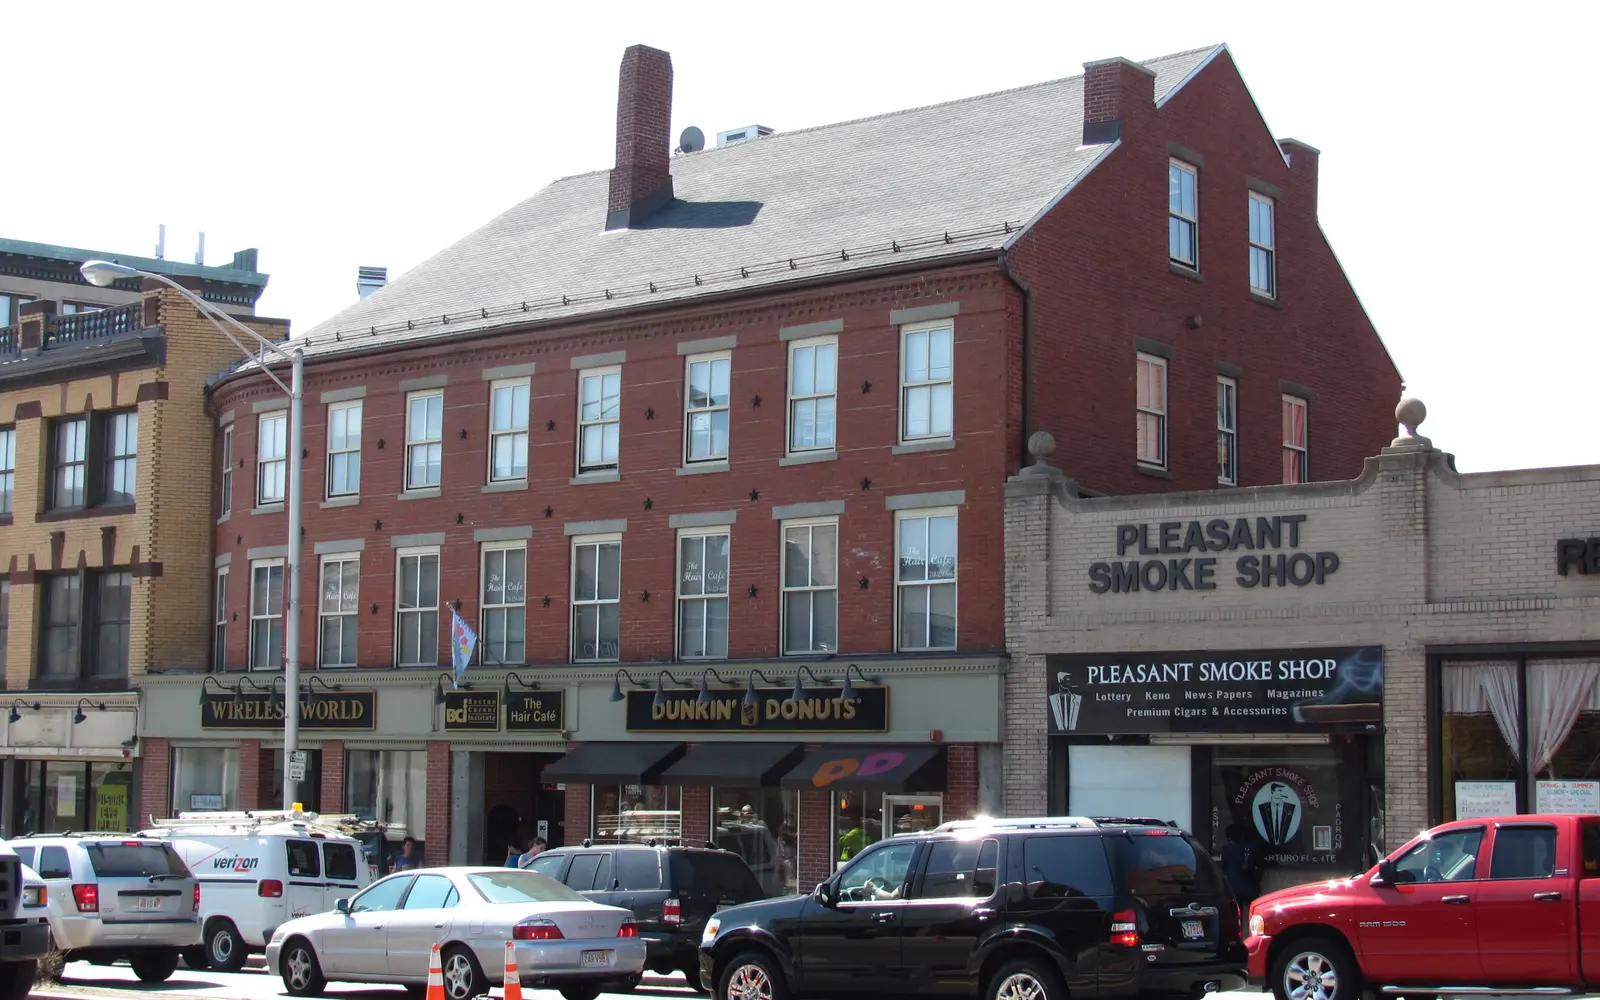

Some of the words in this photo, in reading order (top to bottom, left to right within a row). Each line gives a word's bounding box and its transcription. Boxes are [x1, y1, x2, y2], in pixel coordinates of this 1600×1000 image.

[1116, 514, 1307, 556] PLEASANT
[1088, 557, 1217, 594] SMOKE
[1235, 551, 1340, 588] SHOP
[1086, 662, 1194, 685] PLEASANT
[1199, 660, 1273, 682] SMOKE
[1278, 658, 1337, 680] SHOP
[524, 697, 542, 709] The
[1095, 691, 1132, 703] Lottery
[1145, 691, 1170, 700] Keno
[1184, 690, 1213, 700] News
[1216, 689, 1253, 701] Papers
[1267, 688, 1324, 699] Magazines
[211, 700, 296, 720] WIRELES
[299, 699, 364, 720] WORLD
[511, 710, 531, 722] Hair
[533, 710, 557, 722] Café
[652, 699, 738, 721] DUNKIN'
[1126, 707, 1171, 717] Premium
[1174, 706, 1208, 717] Cigars
[1211, 706, 1220, 716] &
[1223, 706, 1288, 716] Accessories
[1234, 767, 1275, 805] PLEASANT
[1275, 767, 1305, 786] SMOKE
[1303, 784, 1319, 809] SHOP
[213, 853, 259, 872] verizon
